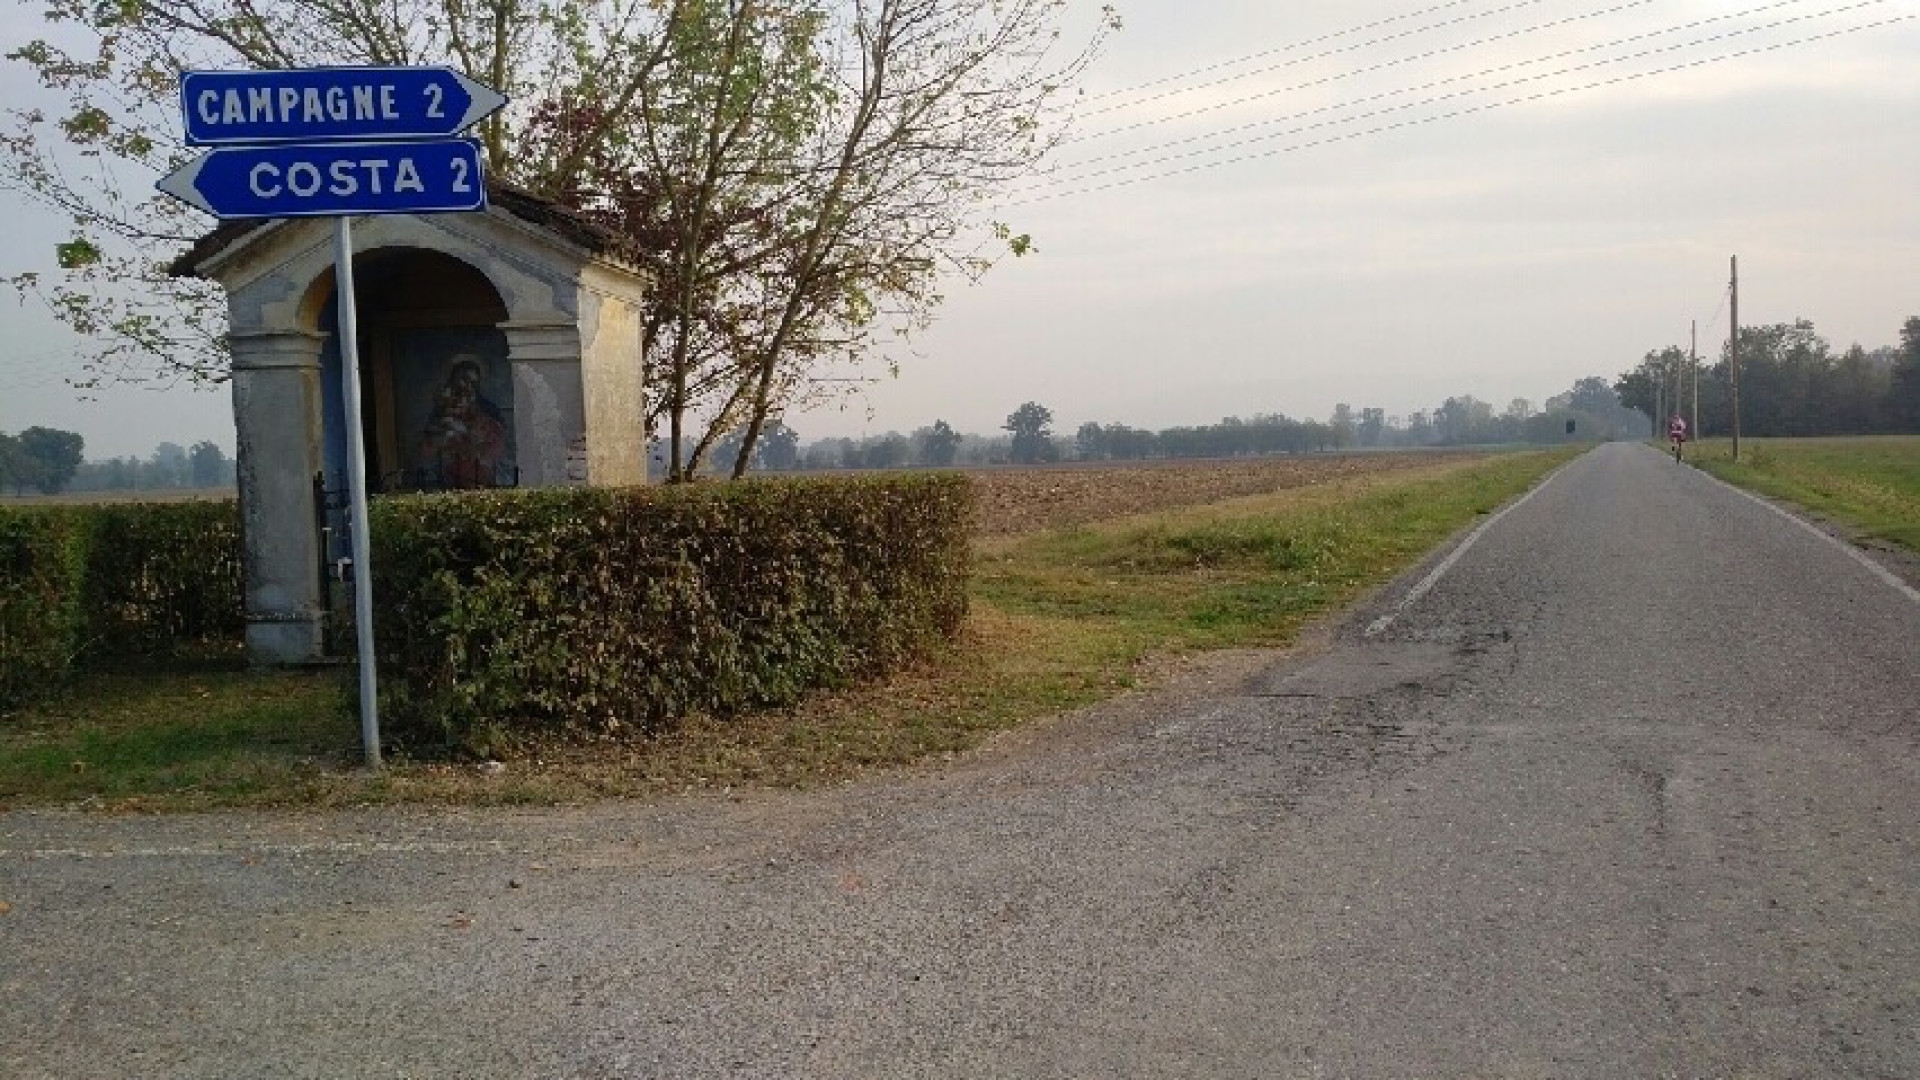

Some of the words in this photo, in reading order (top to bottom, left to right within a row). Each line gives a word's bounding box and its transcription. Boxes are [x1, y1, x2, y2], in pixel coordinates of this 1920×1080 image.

[198, 85, 400, 125] CAMPAGNE
[423, 83, 445, 119] 2
[249, 157, 425, 197] COSTA
[450, 157, 472, 193] 2
